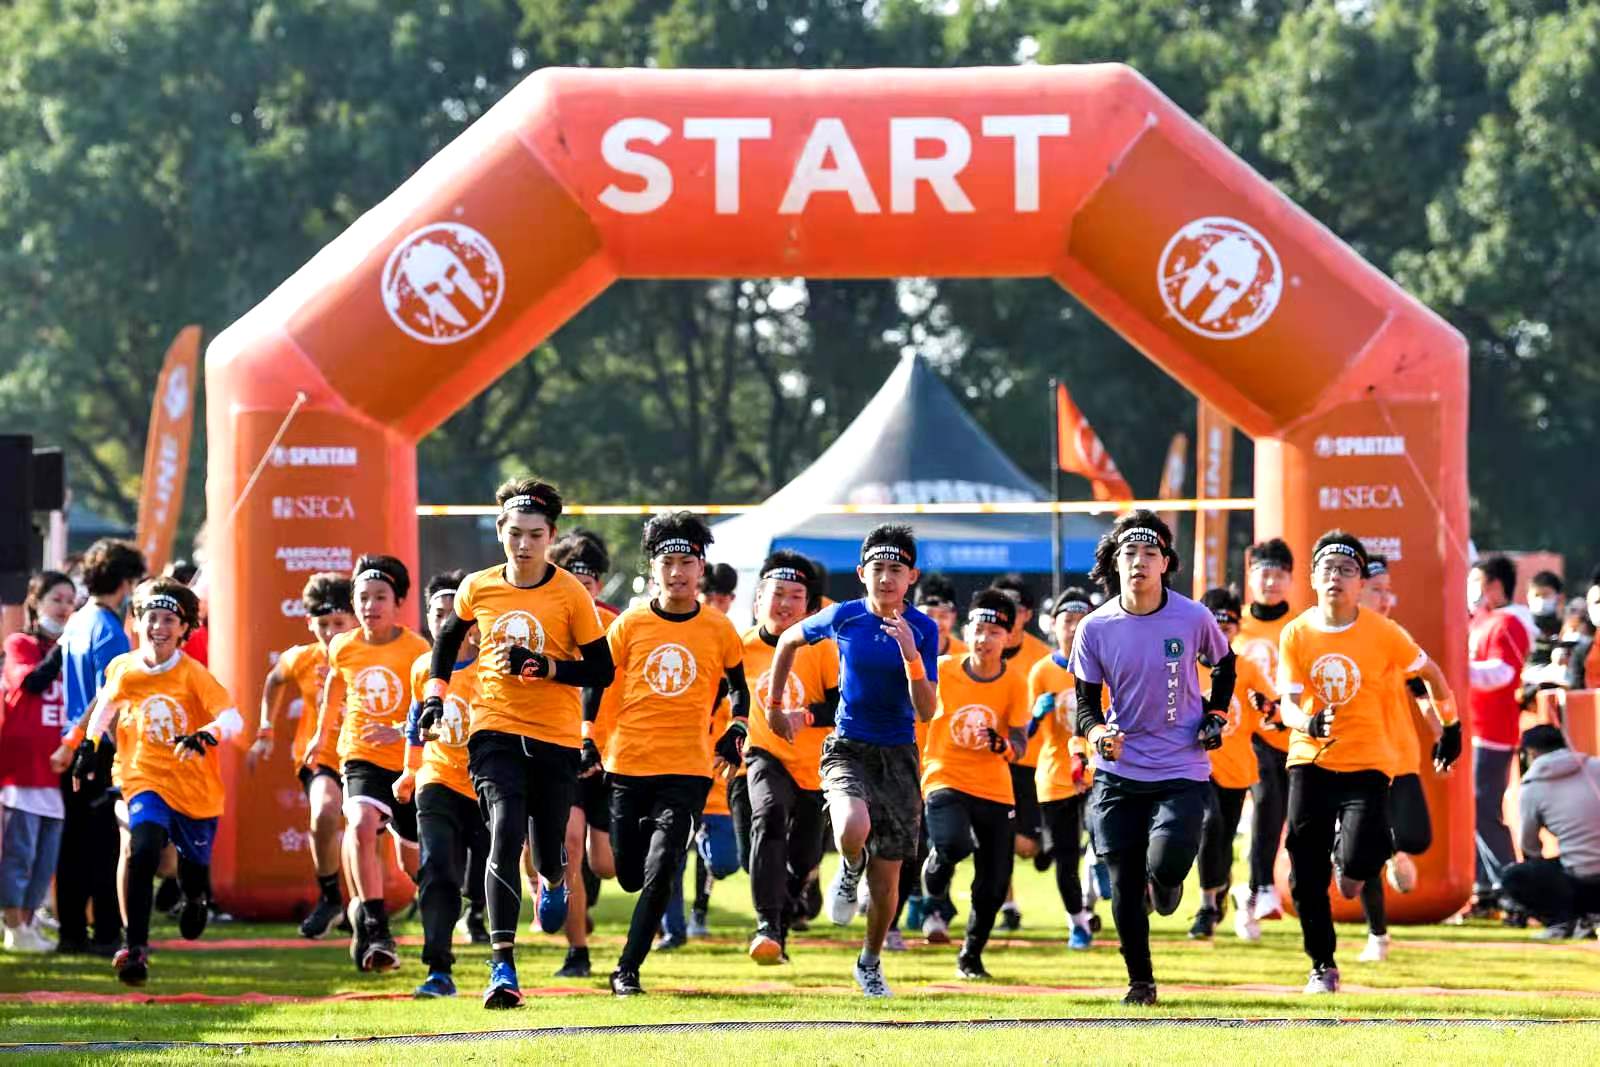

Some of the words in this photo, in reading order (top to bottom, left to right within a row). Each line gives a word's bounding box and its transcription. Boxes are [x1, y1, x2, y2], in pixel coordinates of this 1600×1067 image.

[597, 115, 1070, 214] START
[289, 446, 358, 466] SPARTAN
[1336, 435, 1405, 456] SPARTAN
[296, 495, 355, 519] SECA
[1343, 485, 1404, 509] SECA
[275, 547, 352, 559] AMERICAN
[285, 559, 353, 571] EXPRESS
